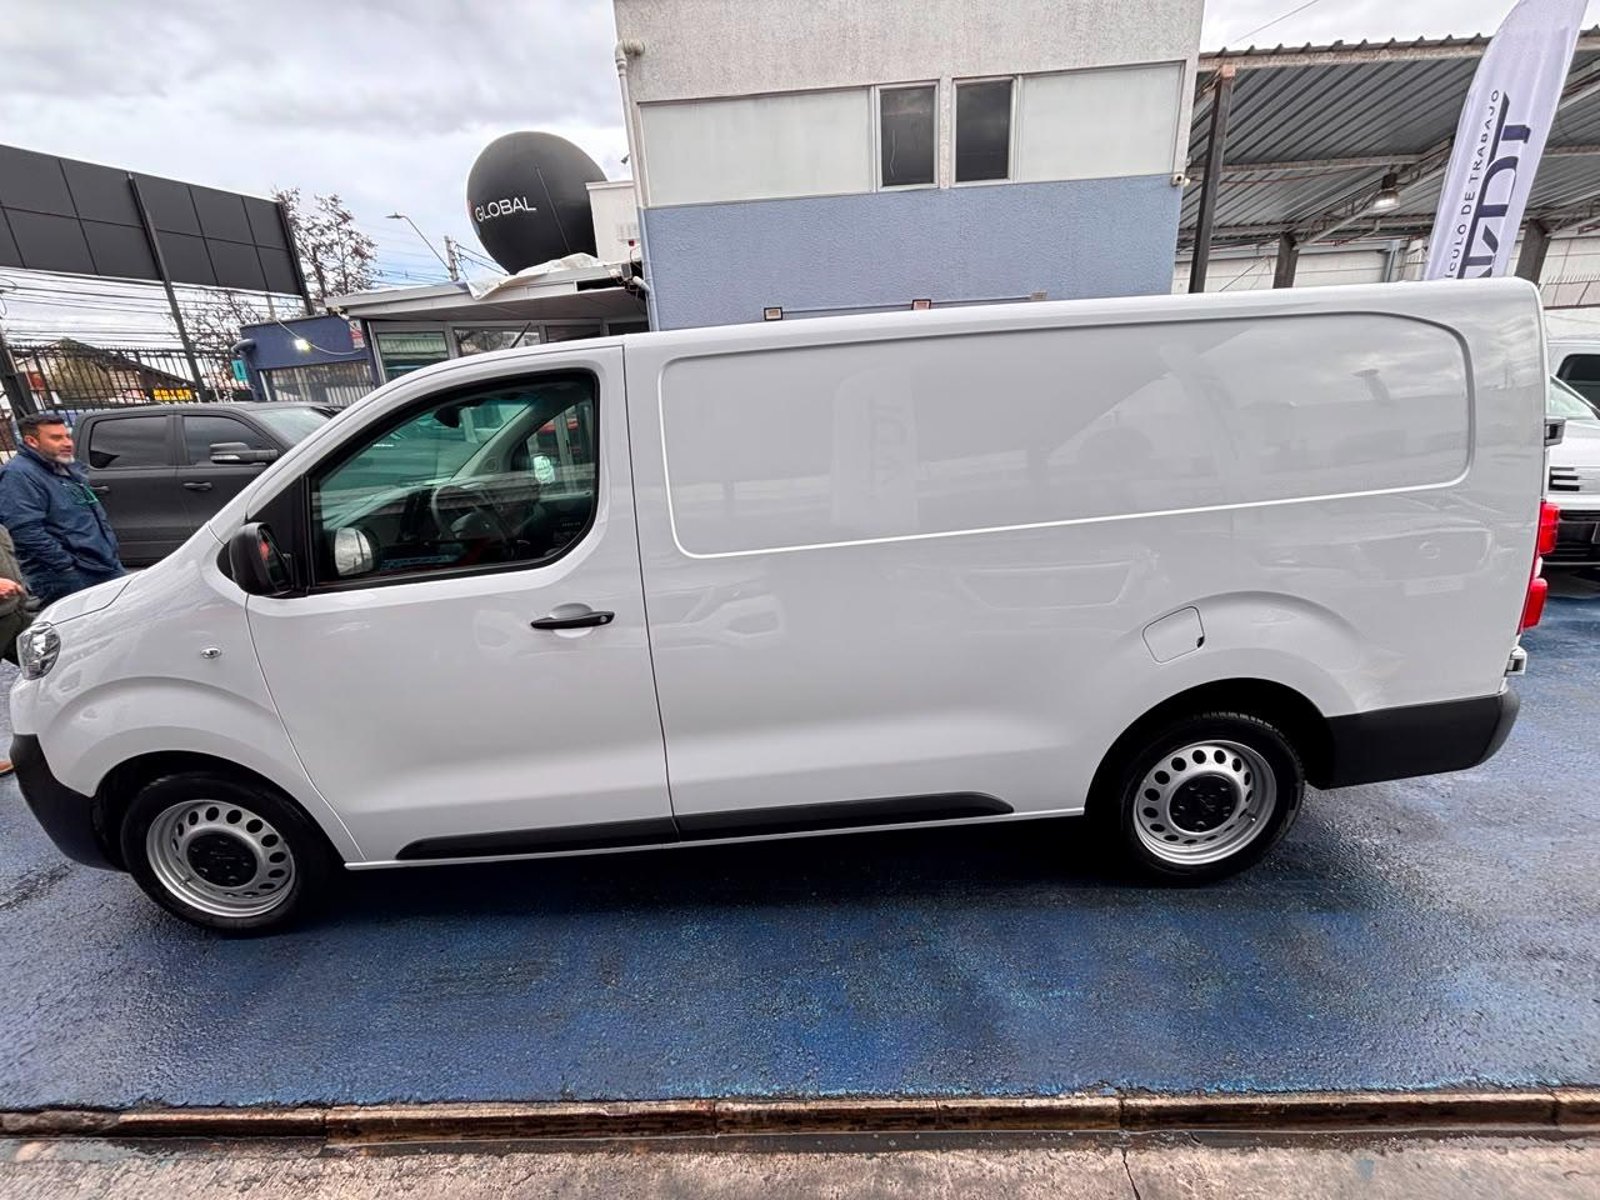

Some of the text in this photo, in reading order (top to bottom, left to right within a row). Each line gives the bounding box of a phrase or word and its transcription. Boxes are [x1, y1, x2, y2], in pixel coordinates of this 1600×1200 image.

[1468, 89, 1500, 184] TRABAJO
[474, 196, 537, 222] GLOBAL
[1461, 191, 1476, 216] DE
